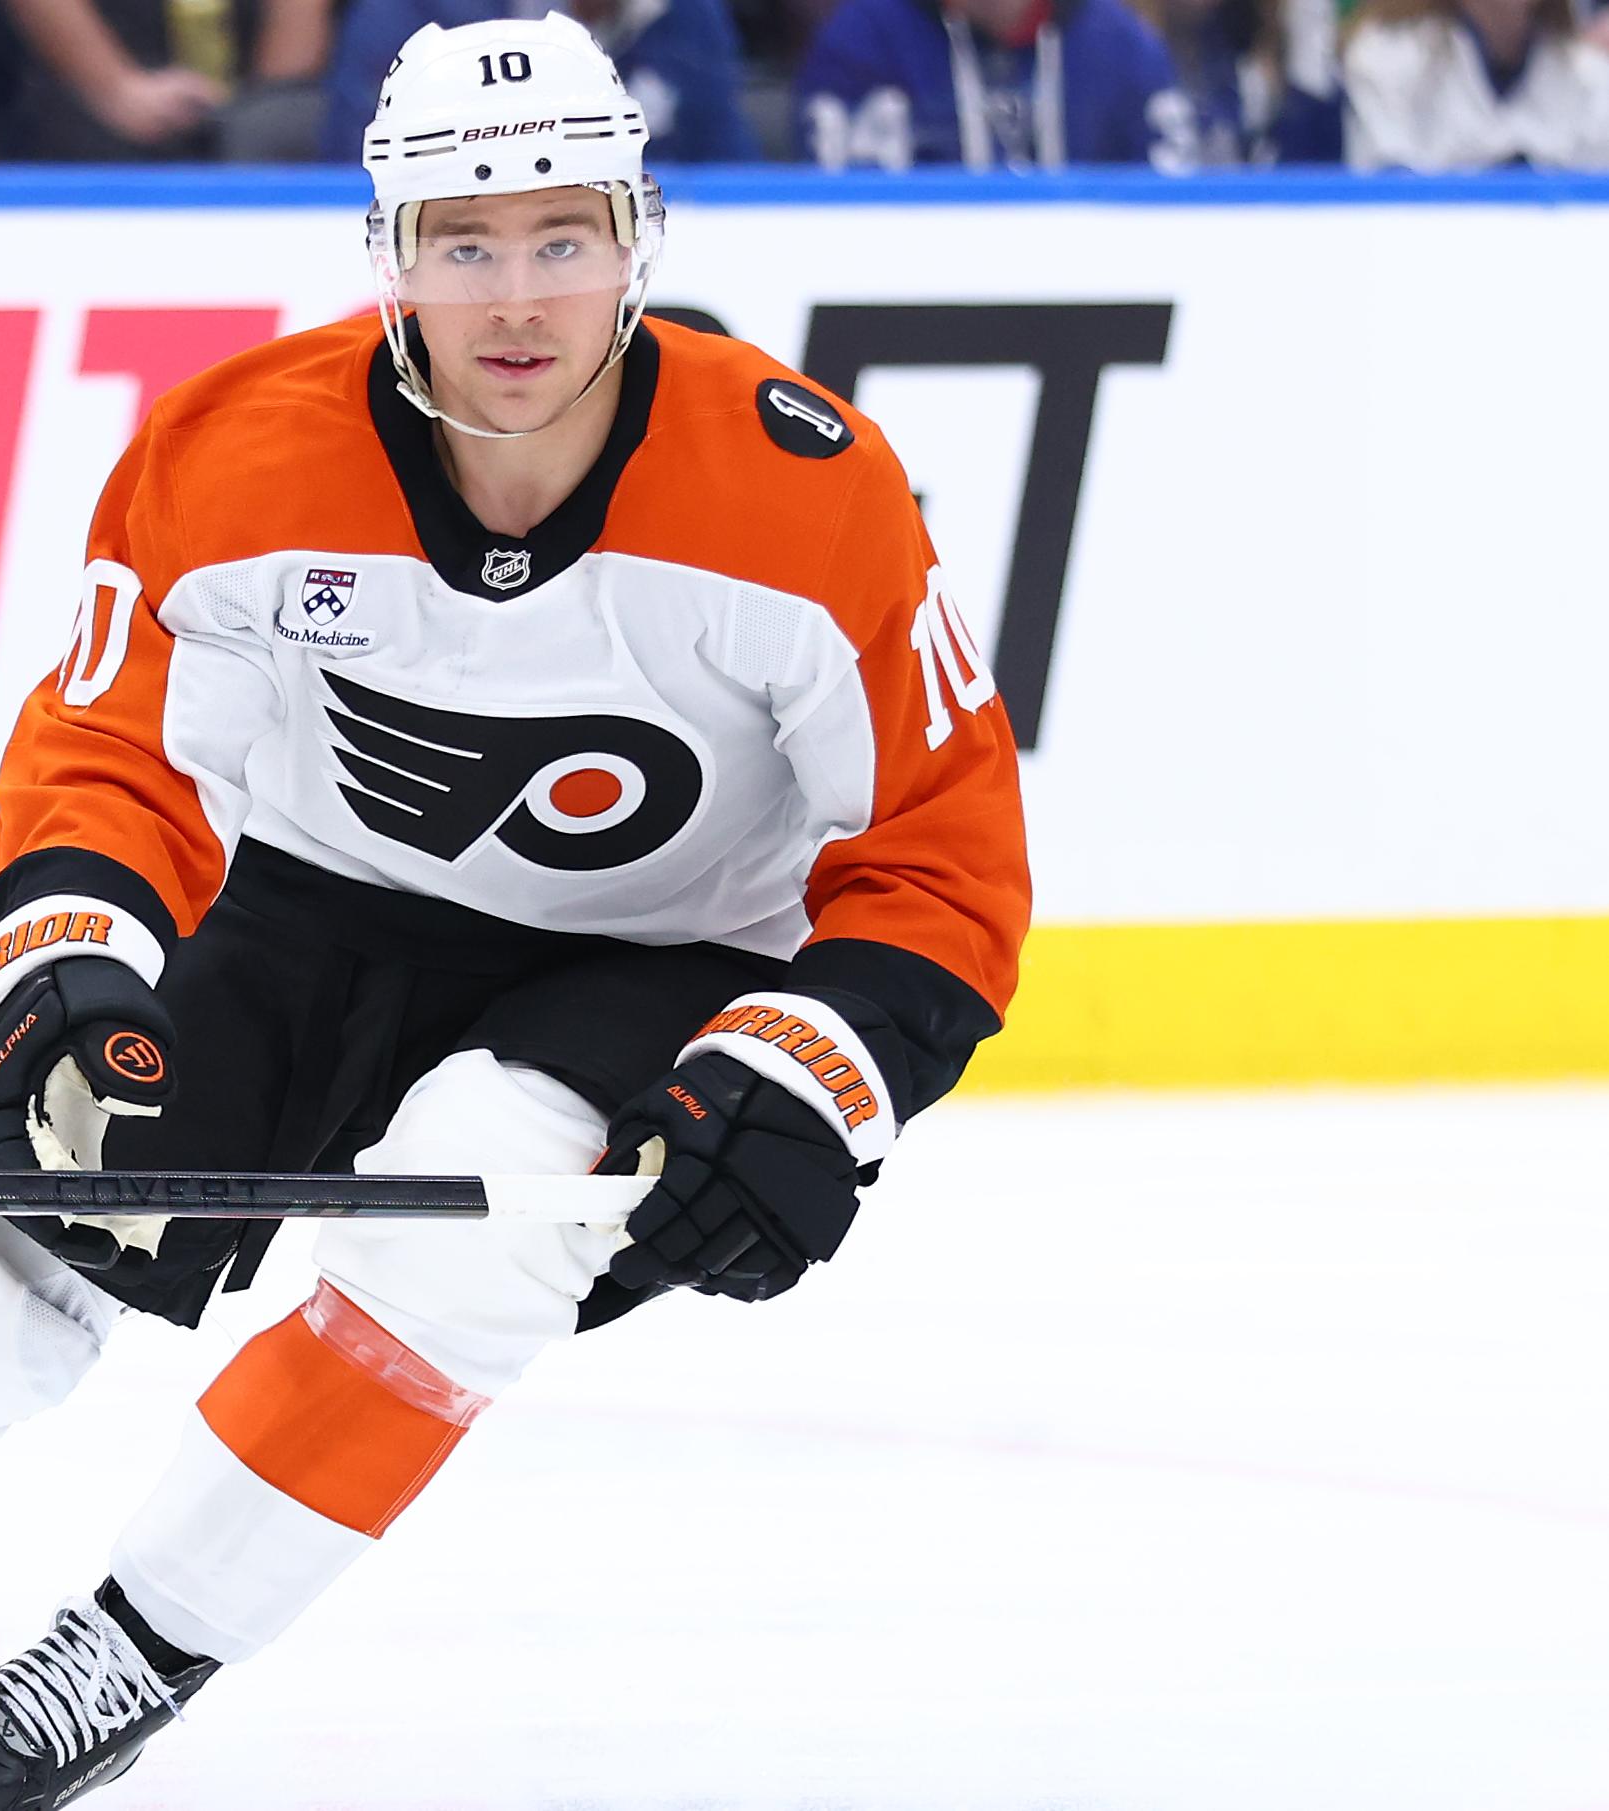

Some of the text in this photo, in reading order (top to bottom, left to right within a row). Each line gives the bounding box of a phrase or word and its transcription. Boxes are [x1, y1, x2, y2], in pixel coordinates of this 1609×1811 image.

[478, 51, 532, 87] 10
[462, 119, 556, 143] BAUER
[492, 560, 522, 580] NHL
[275, 623, 370, 647] enn Medicine
[909, 563, 996, 752] 10
[666, 1085, 708, 1121] ALPHA
[52, 1752, 118, 1808] BAUER
